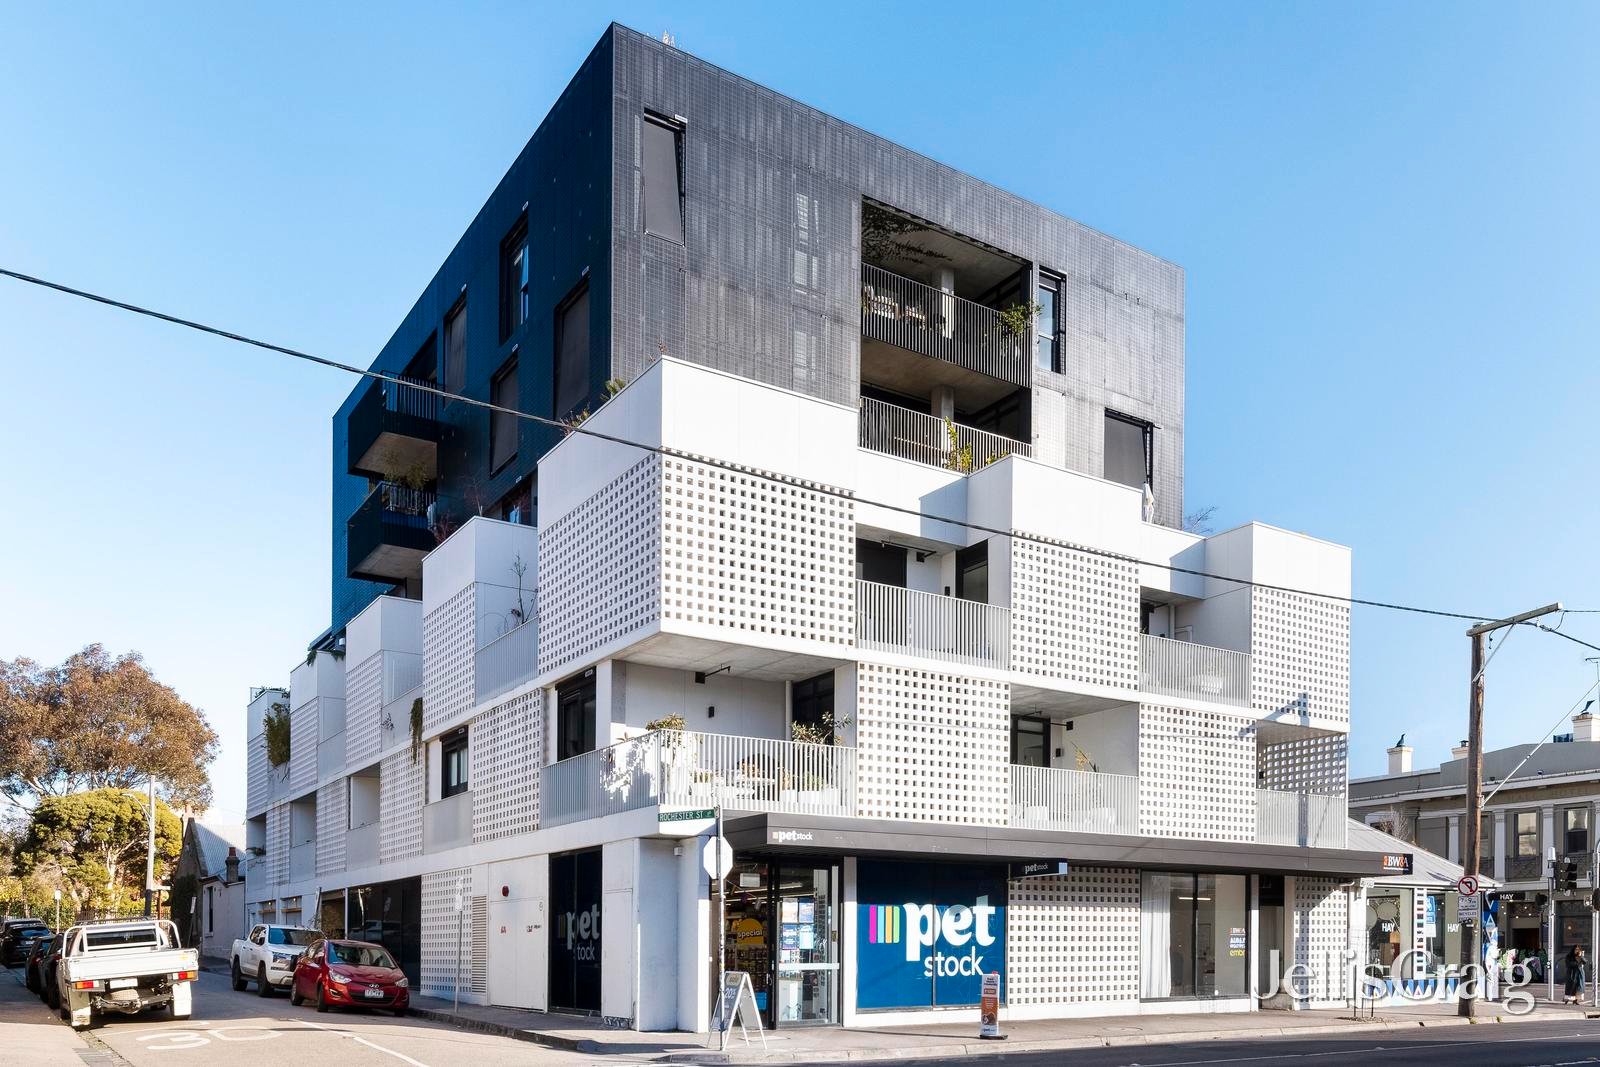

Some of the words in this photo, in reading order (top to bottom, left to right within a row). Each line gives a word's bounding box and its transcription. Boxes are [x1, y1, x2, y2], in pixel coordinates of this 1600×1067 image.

[659, 811, 695, 822] ROCHESTER
[696, 810, 704, 820] ST
[566, 903, 600, 950] pet
[903, 894, 996, 962] pet
[1382, 923, 1395, 933] HAY
[1447, 924, 1460, 933] HAY
[738, 930, 763, 940] special
[924, 945, 984, 977] stock
